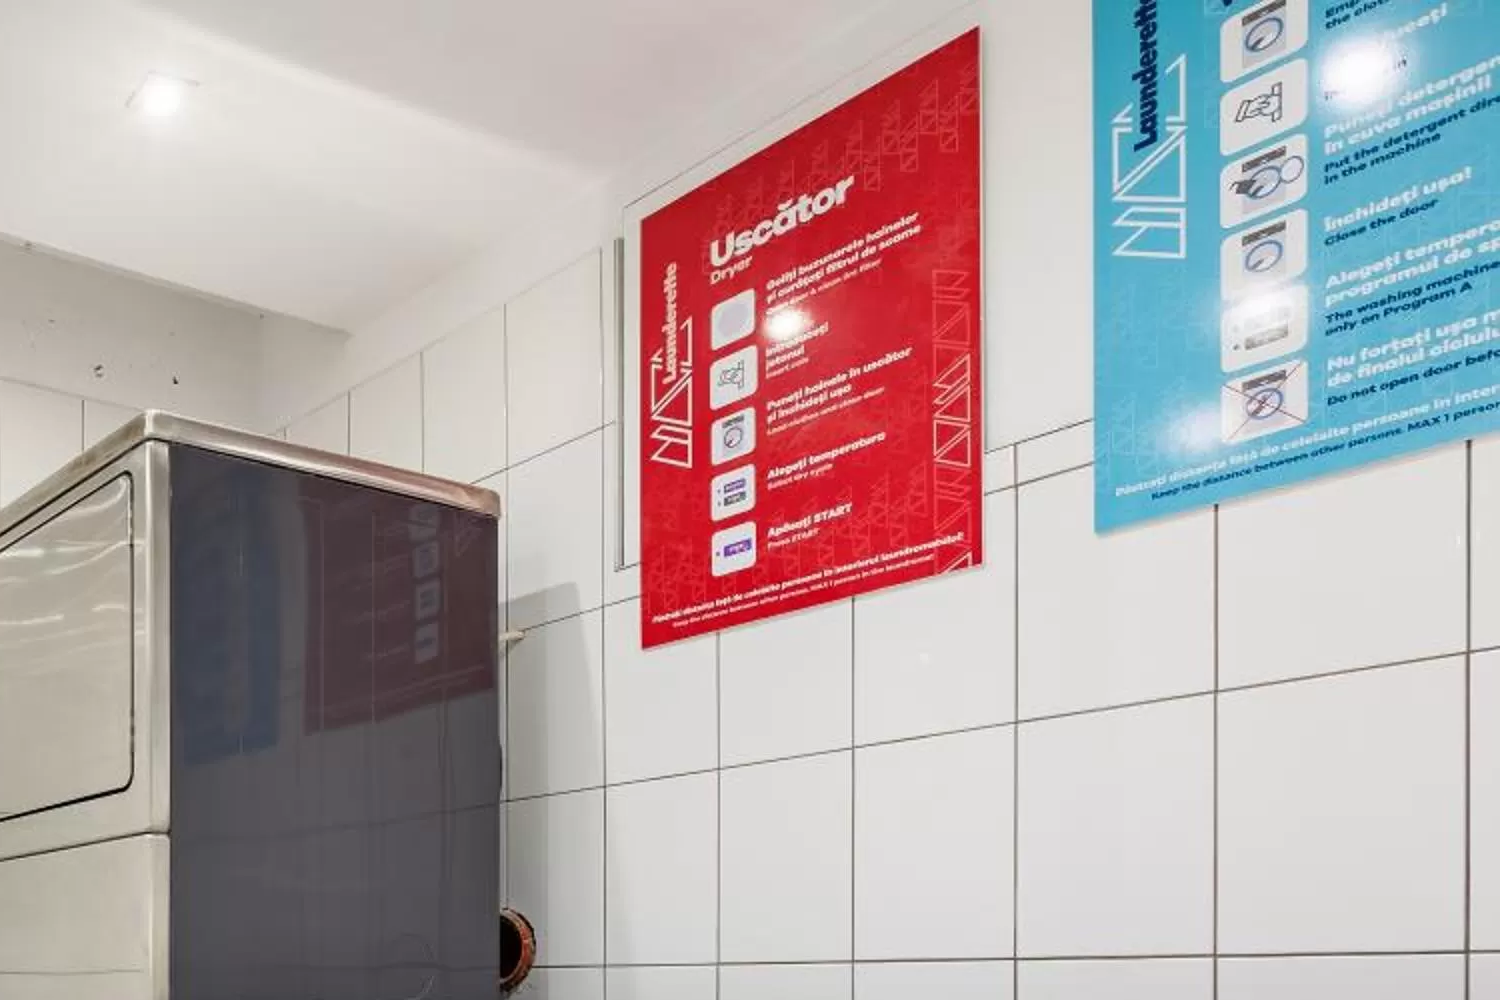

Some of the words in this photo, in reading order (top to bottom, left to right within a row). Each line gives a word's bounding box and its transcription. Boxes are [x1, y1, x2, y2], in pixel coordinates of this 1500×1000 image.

[1324, 155, 1350, 172] Put
[1354, 145, 1380, 161] the
[1383, 109, 1467, 149] detergent
[1348, 116, 1401, 145] cuva
[1324, 173, 1338, 185] in
[1342, 163, 1367, 178] the
[1370, 133, 1441, 167] machine
[710, 175, 855, 267] Uscător
[1324, 225, 1367, 246] Close
[1369, 214, 1397, 230] the
[1399, 199, 1439, 219] door
[710, 255, 753, 285] Dryer
[1325, 255, 1438, 308] programul
[1443, 247, 1473, 265] de
[1325, 309, 1353, 324] The
[1356, 285, 1423, 314] washing
[1425, 261, 1500, 291] machine
[662, 261, 677, 385] Launderette
[1325, 320, 1357, 337] only
[1361, 312, 1380, 325] on
[1383, 288, 1456, 318] Program
[1460, 281, 1473, 293] A
[1327, 354, 1355, 371] Nu
[1327, 372, 1353, 388] de
[1357, 348, 1425, 379] finalul
[1327, 394, 1347, 406] Do
[1351, 384, 1377, 400] not
[1379, 372, 1420, 392] open
[1423, 360, 1462, 380] door
[1352, 404, 1430, 434] persoane
[1151, 487, 1180, 501] Keep
[1203, 467, 1253, 487] distance
[1254, 451, 1309, 474] between
[1311, 441, 1346, 458] other
[1407, 414, 1441, 432] MAX
[813, 502, 853, 524] START
